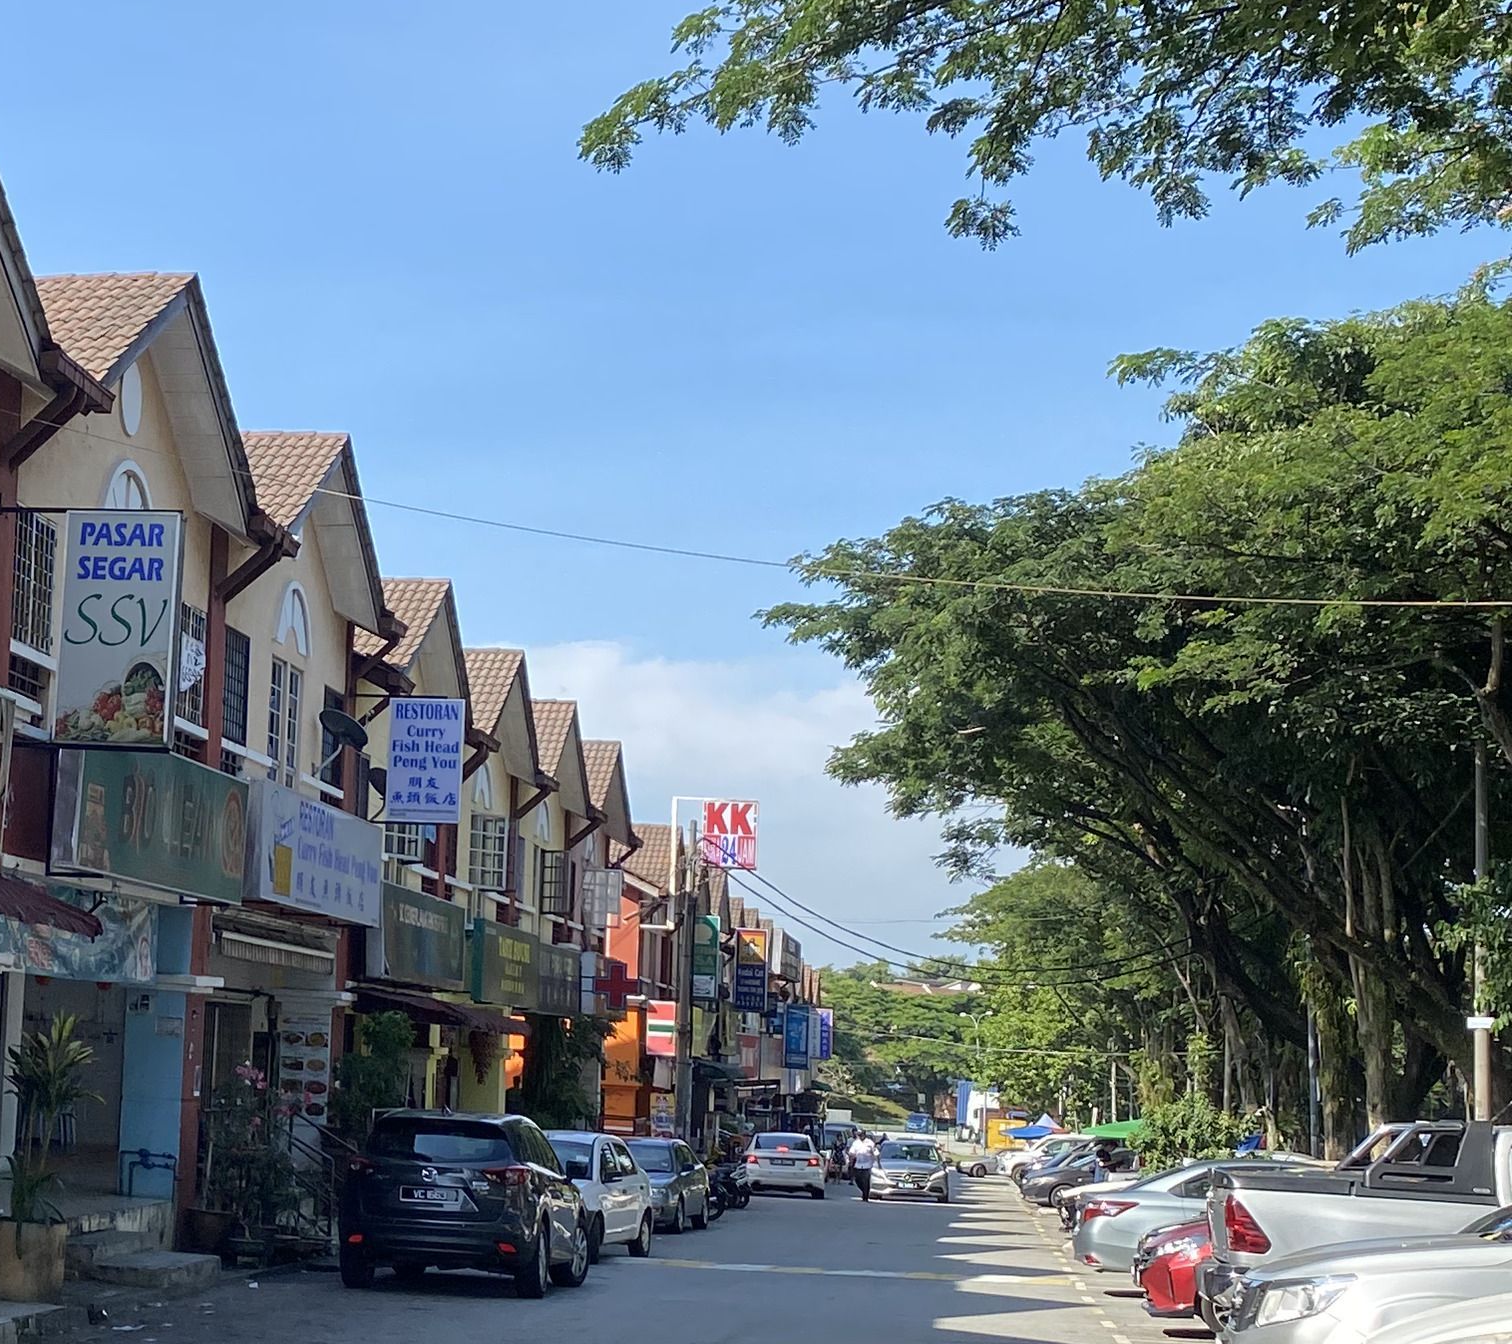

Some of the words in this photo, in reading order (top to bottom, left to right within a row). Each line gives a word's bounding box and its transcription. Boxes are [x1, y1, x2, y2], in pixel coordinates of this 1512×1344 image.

[80, 522, 165, 547] PASAR
[76, 556, 164, 581] SEGAR
[64, 594, 169, 647] SSV
[395, 703, 459, 721] RESTORAN
[407, 724, 446, 740] Curry
[392, 739, 420, 753] Fish
[424, 740, 460, 754] Head
[393, 754, 427, 771] Peng
[432, 756, 457, 770] You
[706, 802, 754, 834] KK
[721, 836, 737, 864] 24
